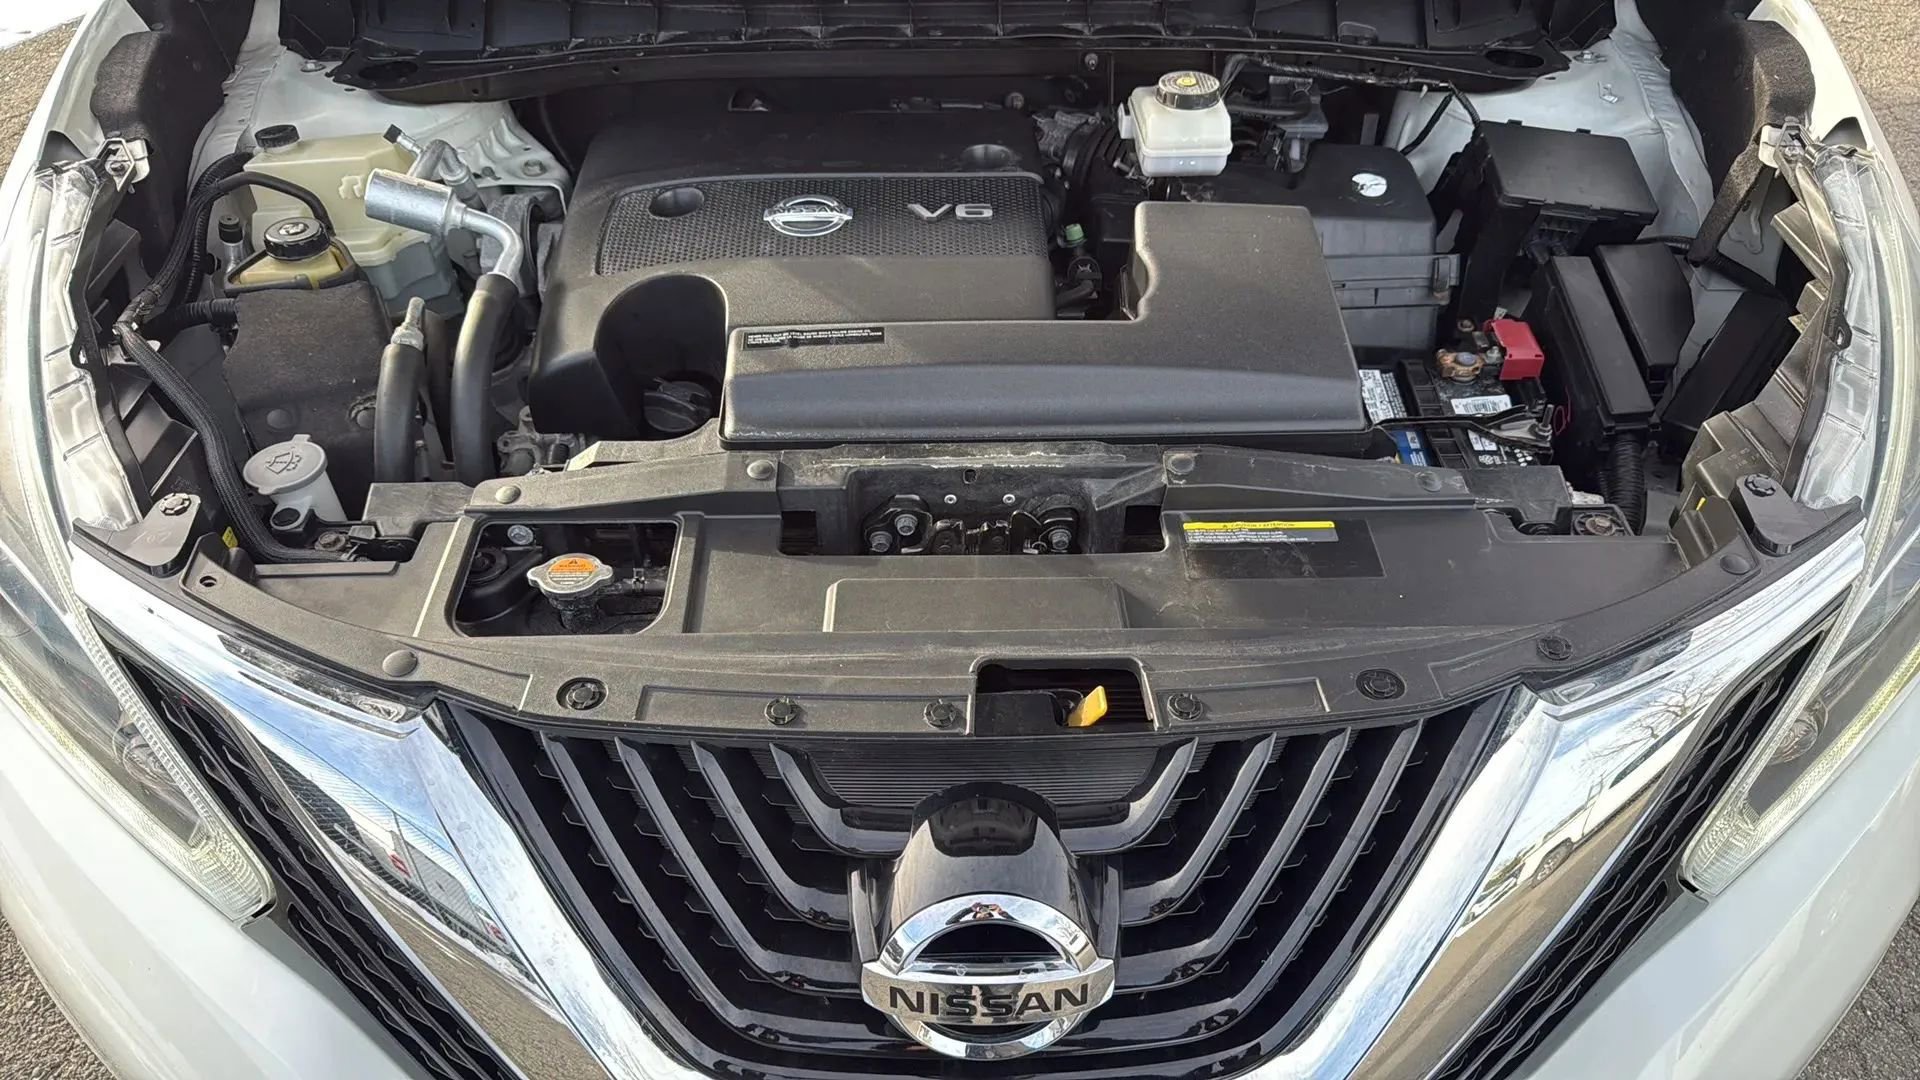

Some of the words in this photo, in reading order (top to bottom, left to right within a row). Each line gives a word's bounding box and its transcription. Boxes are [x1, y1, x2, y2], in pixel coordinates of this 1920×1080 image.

[774, 204, 845, 214] NISSAN
[907, 203, 993, 221] V6
[889, 983, 1088, 1016] NISSAN
